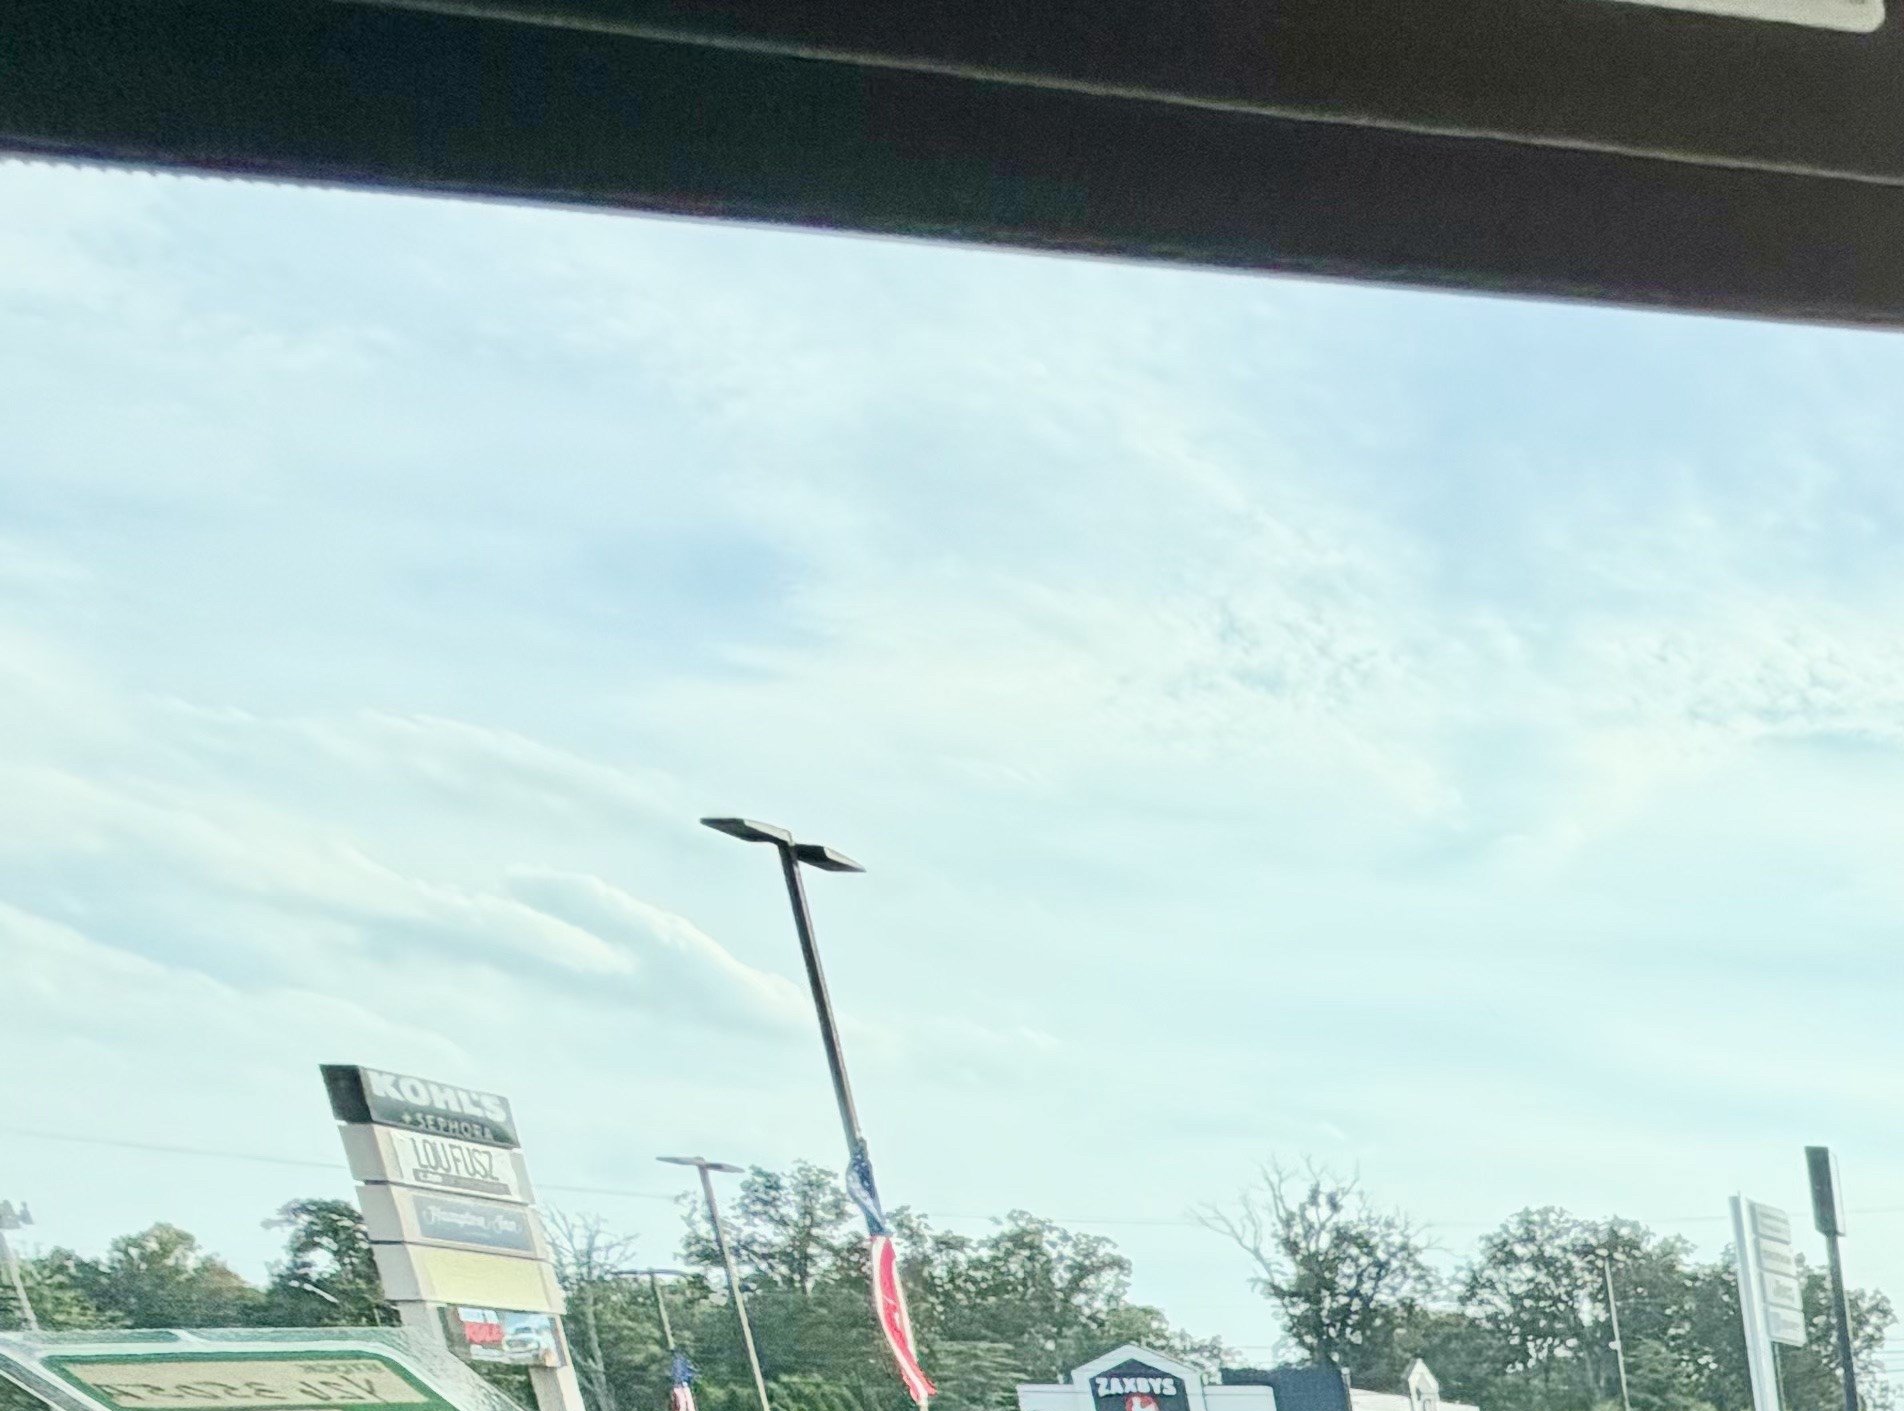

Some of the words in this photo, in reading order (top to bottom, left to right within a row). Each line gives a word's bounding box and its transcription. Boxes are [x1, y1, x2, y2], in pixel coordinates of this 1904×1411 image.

[366, 1070, 506, 1122] KOHL'S
[416, 1112, 494, 1140] SEPHORA
[410, 1137, 450, 1172] LOU
[450, 1142, 499, 1181] FUSZ
[1096, 1378, 1177, 1396] ZAXBYS
